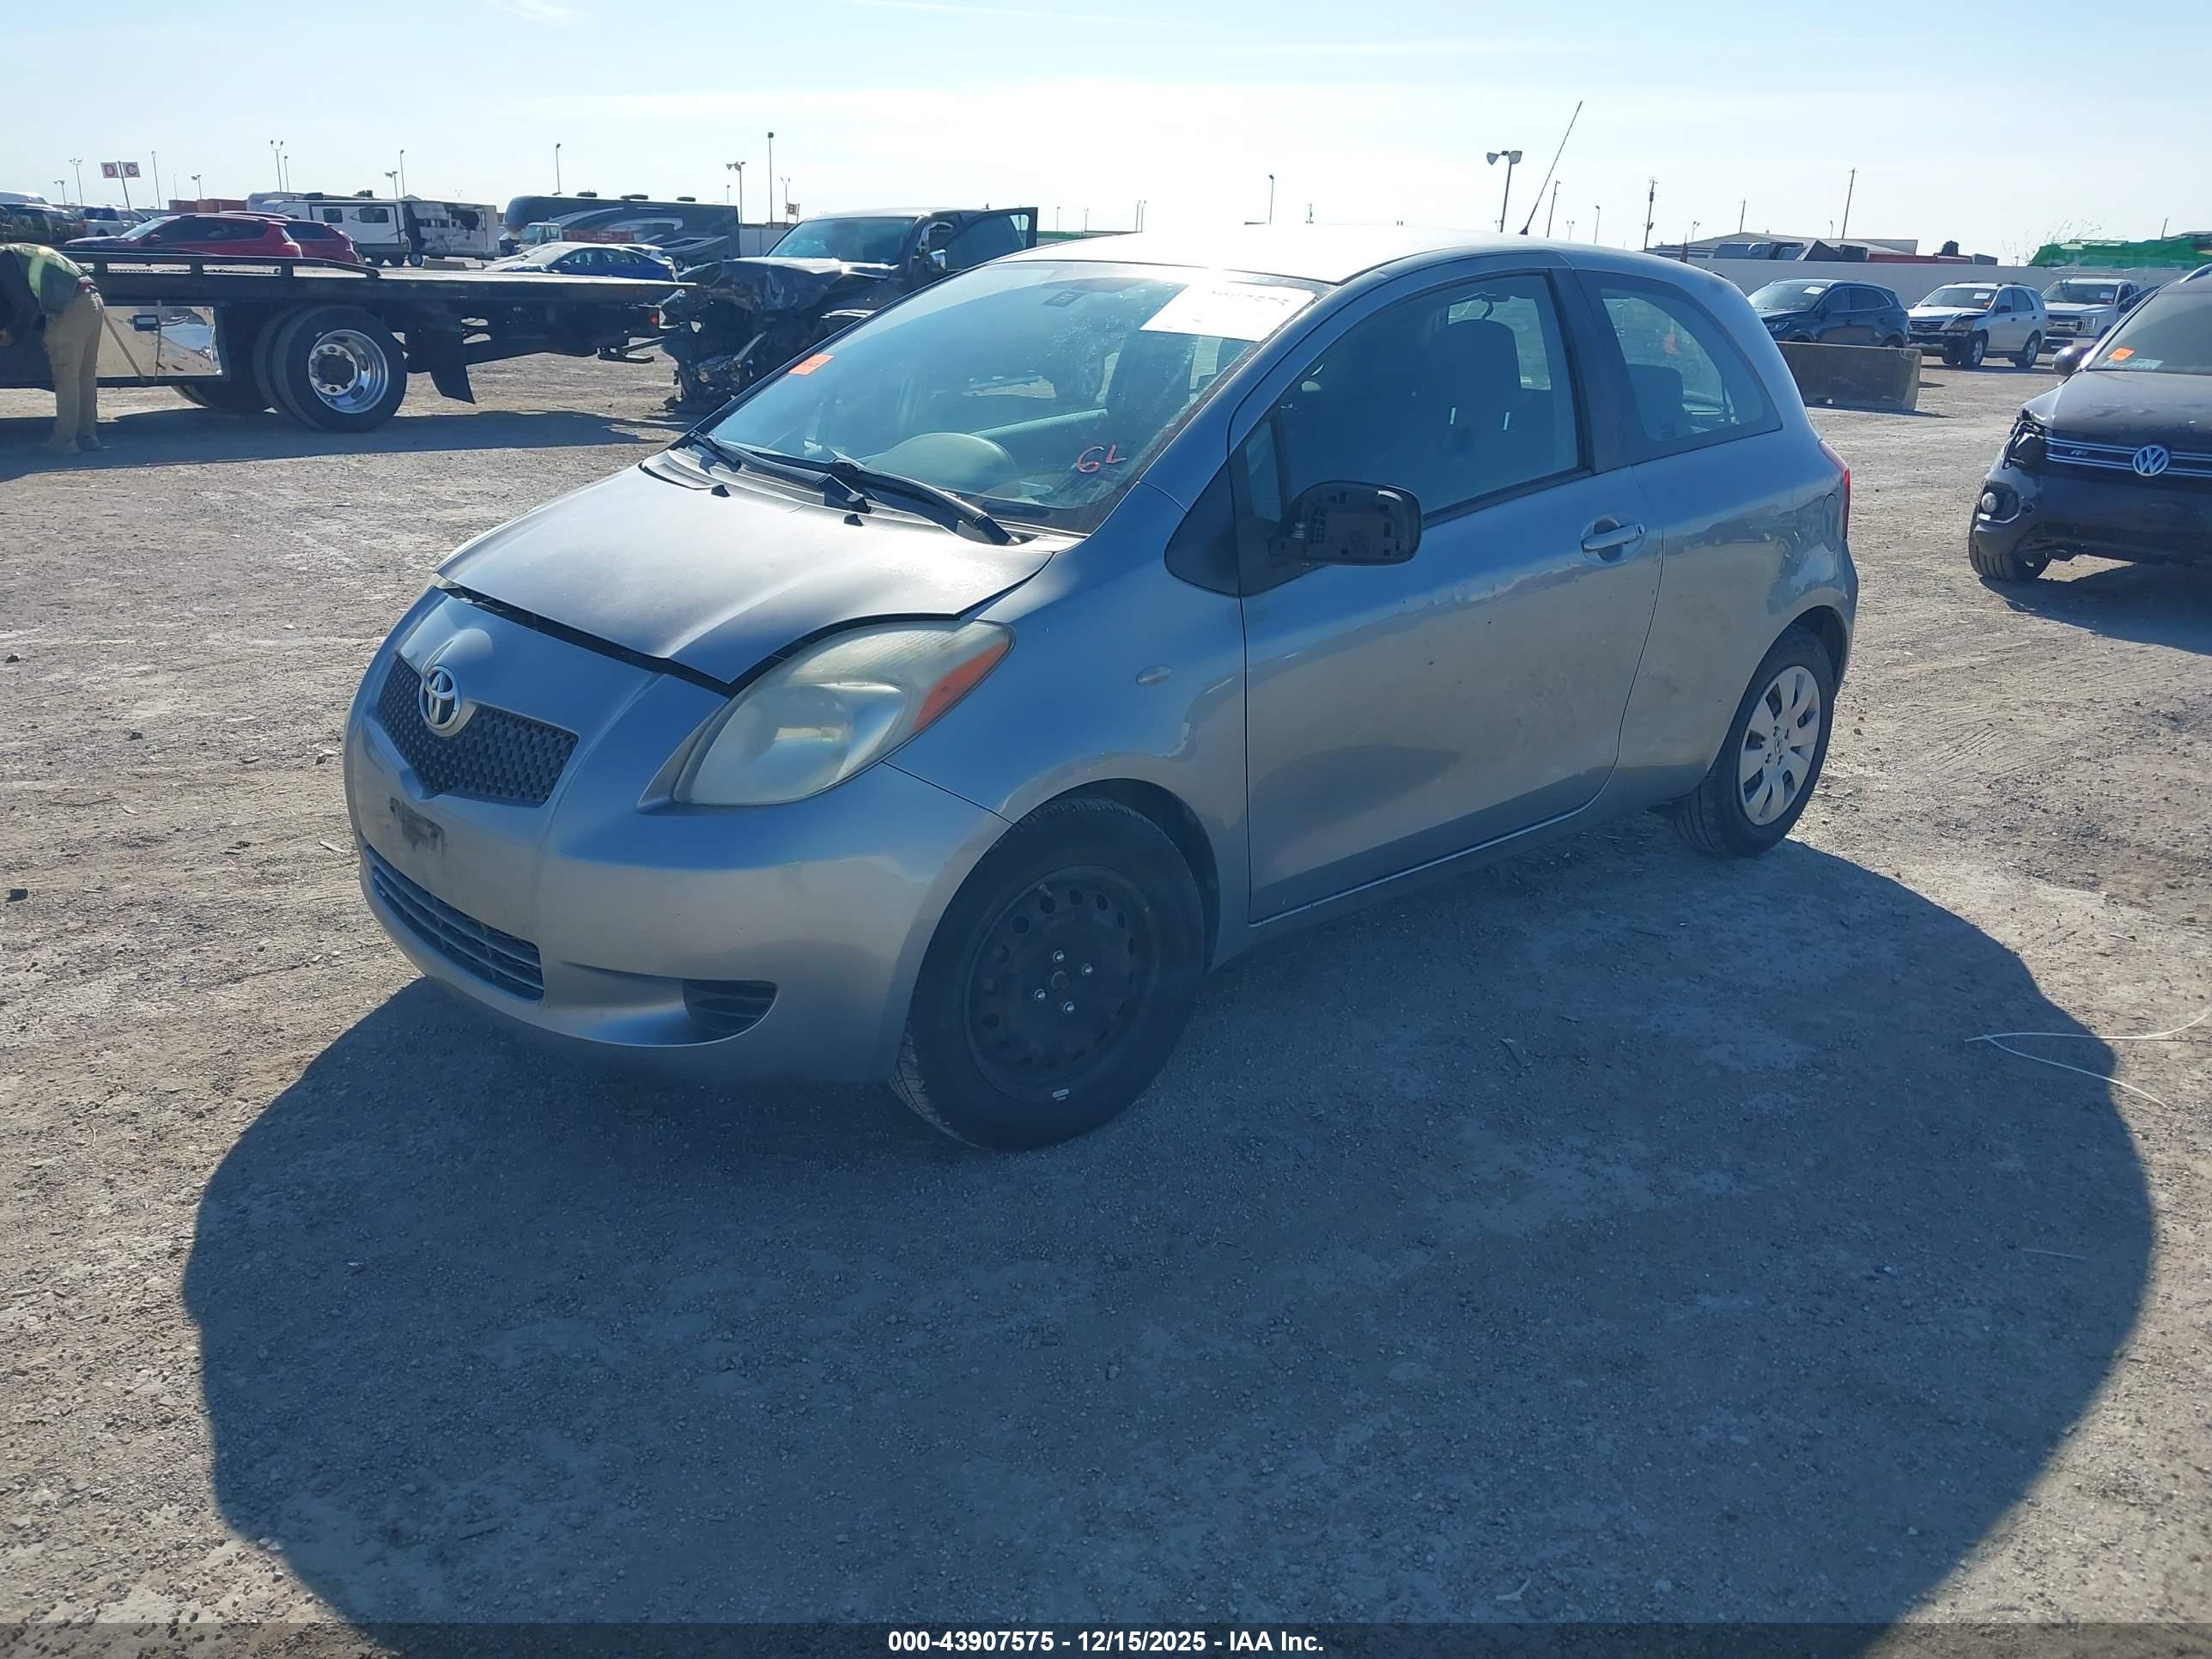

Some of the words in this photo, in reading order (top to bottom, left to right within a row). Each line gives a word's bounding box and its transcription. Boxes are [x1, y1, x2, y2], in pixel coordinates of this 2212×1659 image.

[103, 164, 116, 177] D
[125, 163, 137, 176] C
[2135, 446, 2167, 475] VW
